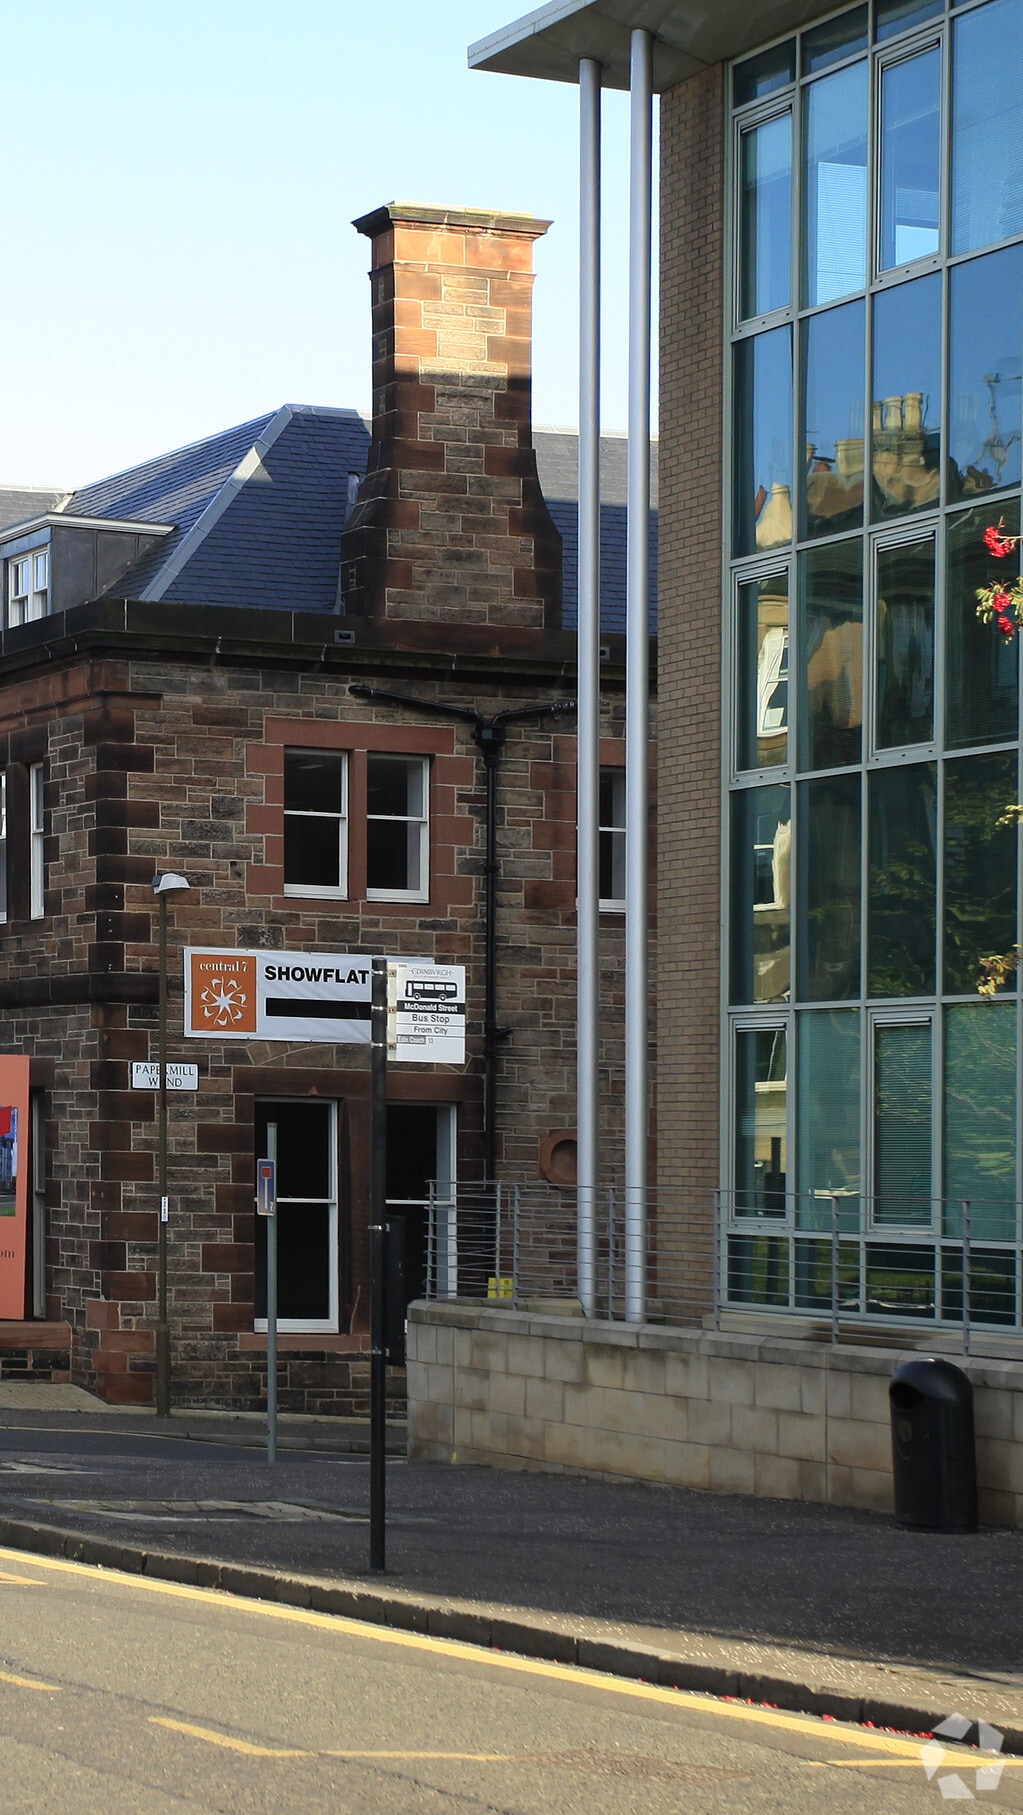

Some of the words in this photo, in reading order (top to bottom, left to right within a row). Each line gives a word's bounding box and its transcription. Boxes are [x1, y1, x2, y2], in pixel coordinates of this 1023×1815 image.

[199, 961, 239, 971] central
[242, 961, 248, 972] 7
[264, 965, 369, 984] SHOWFLAT
[404, 1003, 436, 1011] McDonald
[438, 1004, 458, 1012] Street
[412, 1014, 428, 1022] Bus
[431, 1014, 450, 1024] Stop
[434, 1027, 448, 1035] City
[136, 1065, 194, 1076] PAPEMILL
[149, 1077, 182, 1087] WND
